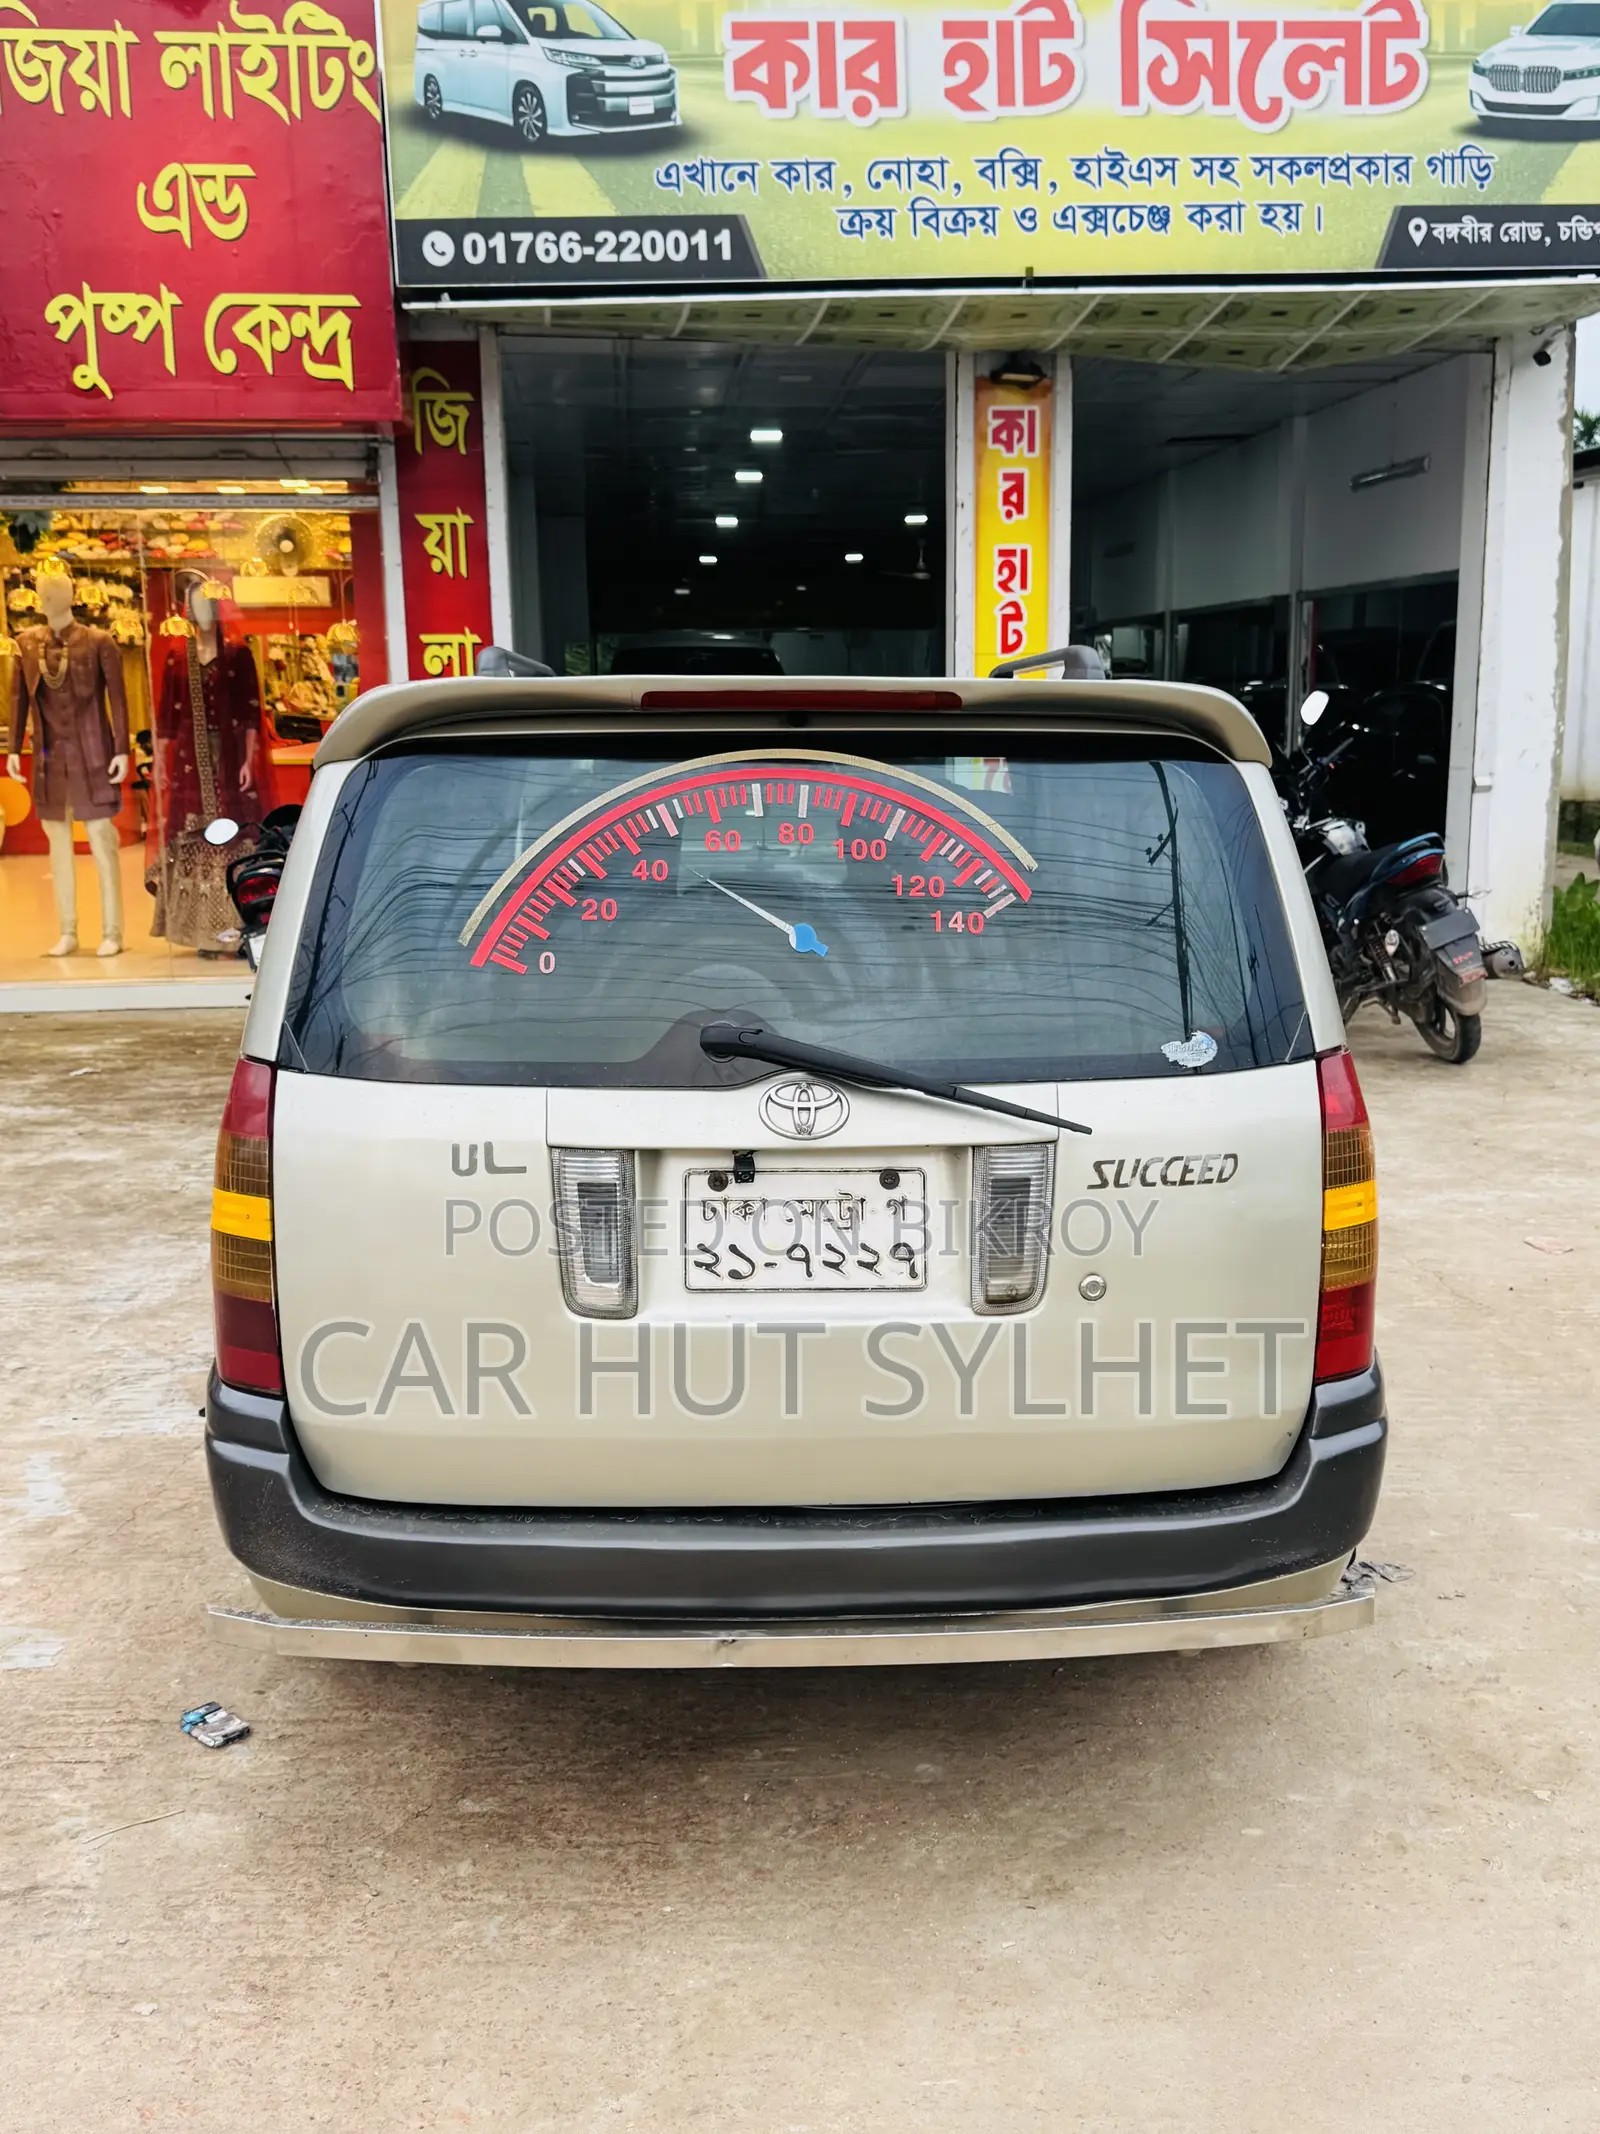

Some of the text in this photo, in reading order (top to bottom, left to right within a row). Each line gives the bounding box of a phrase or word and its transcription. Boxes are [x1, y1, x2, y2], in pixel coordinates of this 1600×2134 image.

[154, 0, 382, 124] লাইটিং
[731, 0, 1421, 124] কার হাট সিলেট
[656, 158, 758, 193] এখানে
[773, 158, 852, 197] কার,
[868, 157, 962, 195] নোহা,
[1070, 147, 1179, 188] হাইএস
[1189, 157, 1240, 188] সহ
[1426, 145, 1494, 189] গাড়ি
[835, 208, 896, 238] ক্রয়
[907, 197, 1000, 237] বিক্রয়
[1014, 207, 1038, 233] ও
[1053, 205, 1171, 236] এক্সচেঞ্জ
[1183, 202, 1246, 233] করা
[1430, 215, 1494, 245] বঙ্গবীর
[1500, 220, 1552, 247] রোড,
[463, 229, 733, 264] 01766-220011
[44, 281, 361, 400] পুষ্প কেন্দ্র
[705, 830, 741, 853] 60
[779, 823, 815, 845] 80
[833, 838, 888, 862] 100
[632, 859, 669, 882] 40
[891, 875, 946, 898] 120
[581, 898, 619, 922] 20
[931, 911, 985, 935] 140
[538, 951, 556, 974] 0
[1087, 1153, 1239, 1190] SUCCEED
